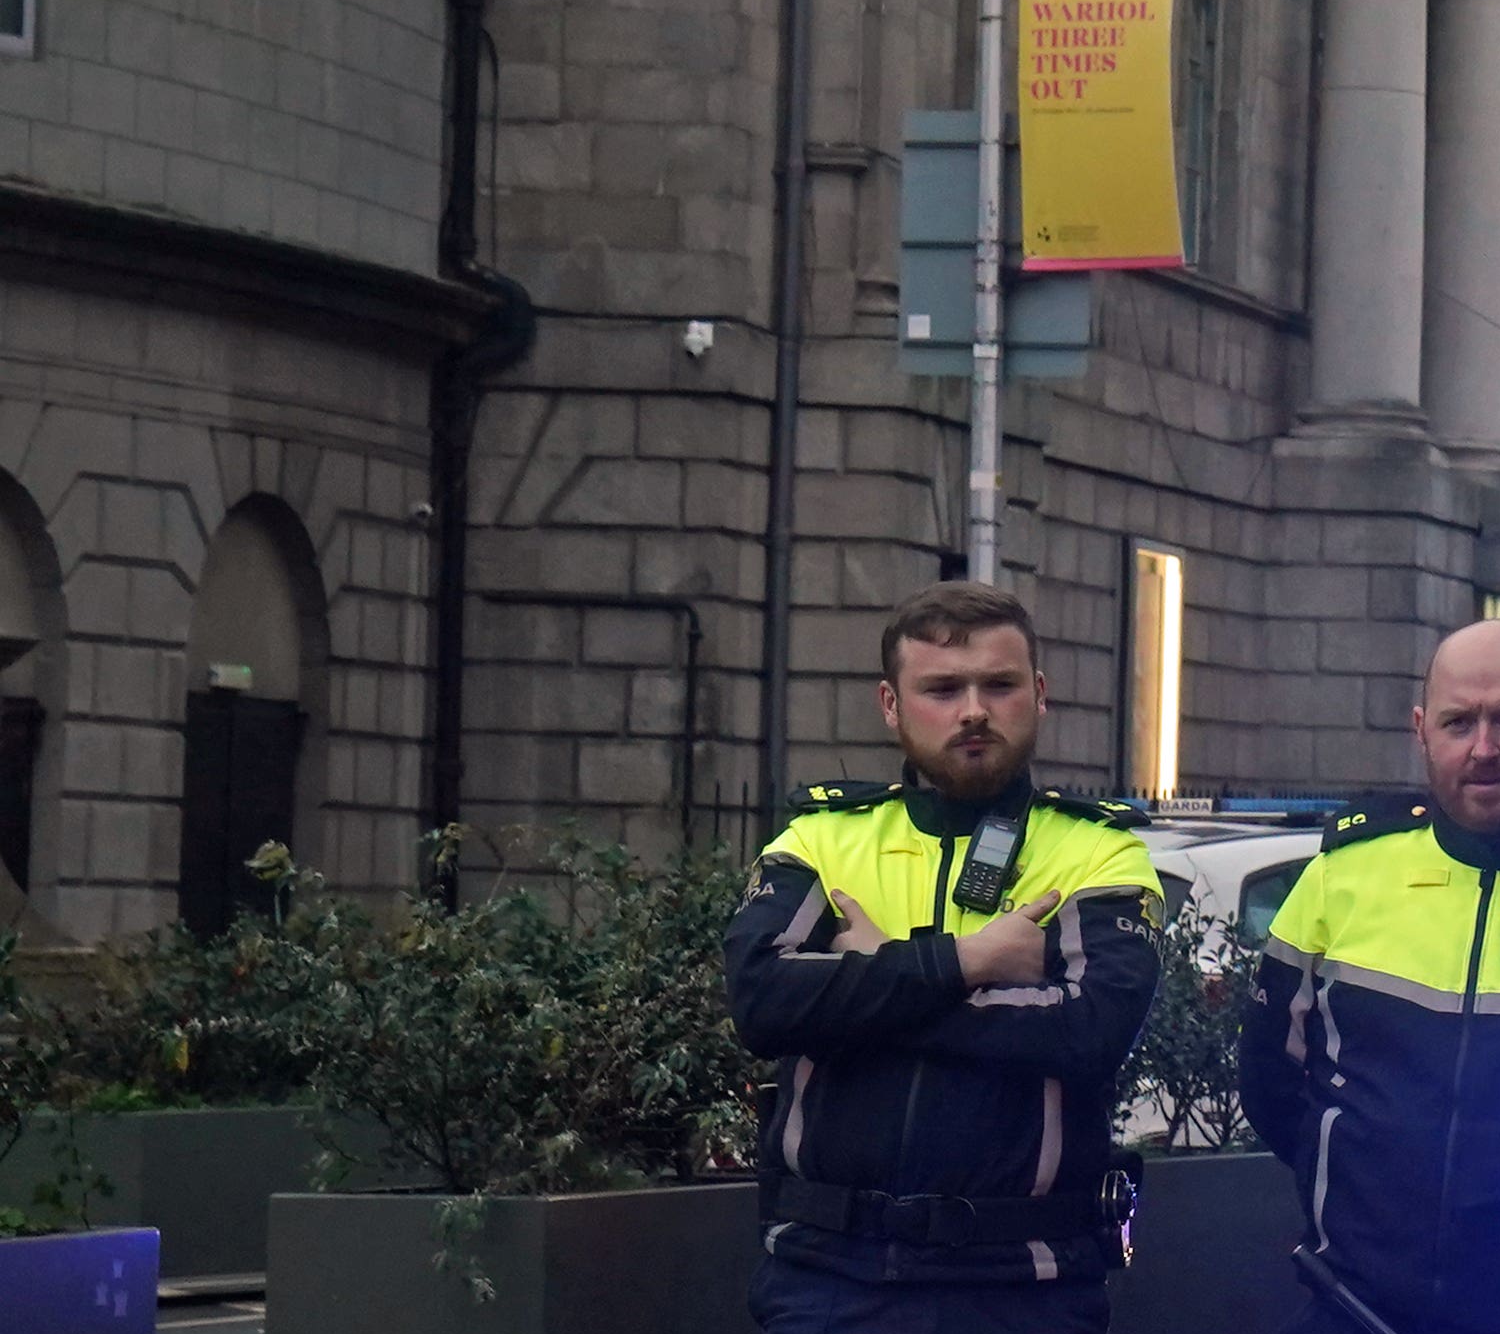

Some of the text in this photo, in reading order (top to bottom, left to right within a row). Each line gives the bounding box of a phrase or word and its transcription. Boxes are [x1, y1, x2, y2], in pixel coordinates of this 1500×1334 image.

[1032, 1, 1155, 22] WARHOL
[1031, 27, 1125, 48] THREE
[1031, 53, 1117, 74] TIMES
[1030, 79, 1088, 101] OUT
[1160, 801, 1210, 812] GARDA
